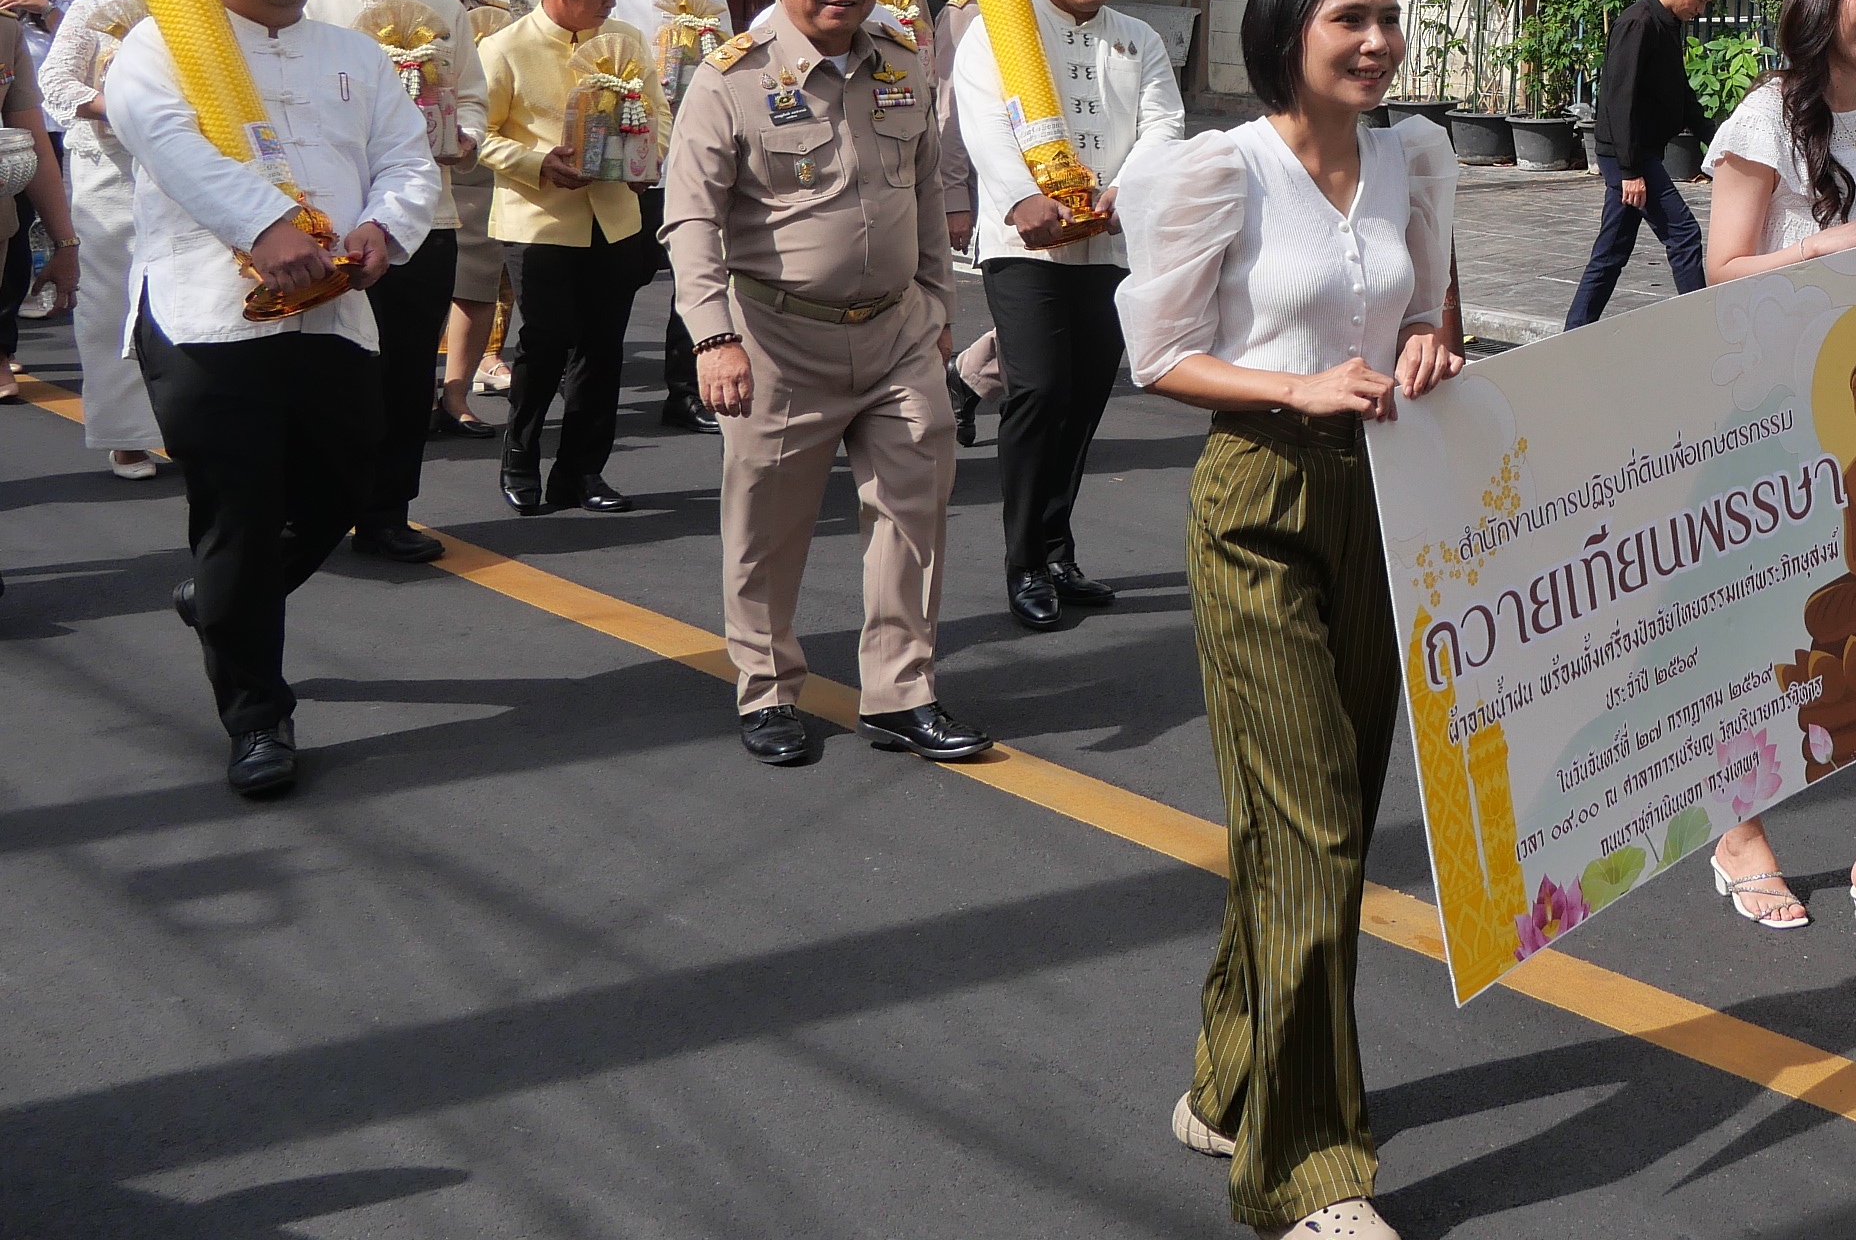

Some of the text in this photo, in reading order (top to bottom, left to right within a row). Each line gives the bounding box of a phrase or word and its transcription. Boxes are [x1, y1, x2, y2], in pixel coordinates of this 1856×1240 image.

[1457, 408, 1794, 562] สำนักงานการปฏิรูปที่ดินเพื่อเกษตรกรรม
[1424, 457, 1848, 686] ถวายเทียนพรรษา
[1448, 674, 1535, 745] ผ้าอาบน้ำฝน
[1555, 661, 1774, 794] ในวันจันทร์ที่ ๒๗ กรกฎาคม ๒๕๖๙
[1605, 645, 1699, 712] ประจำปี ๒๕๖๙
[1515, 828, 1546, 863] เวลา
[1550, 801, 1600, 841] ๐๙.๐๐
[1603, 785, 1619, 809] ณ
[1622, 731, 1715, 797] ศาลาการเปรียญ
[1599, 750, 1761, 858] ถนนราชดำเนินนอก กรุงเทพฯ
